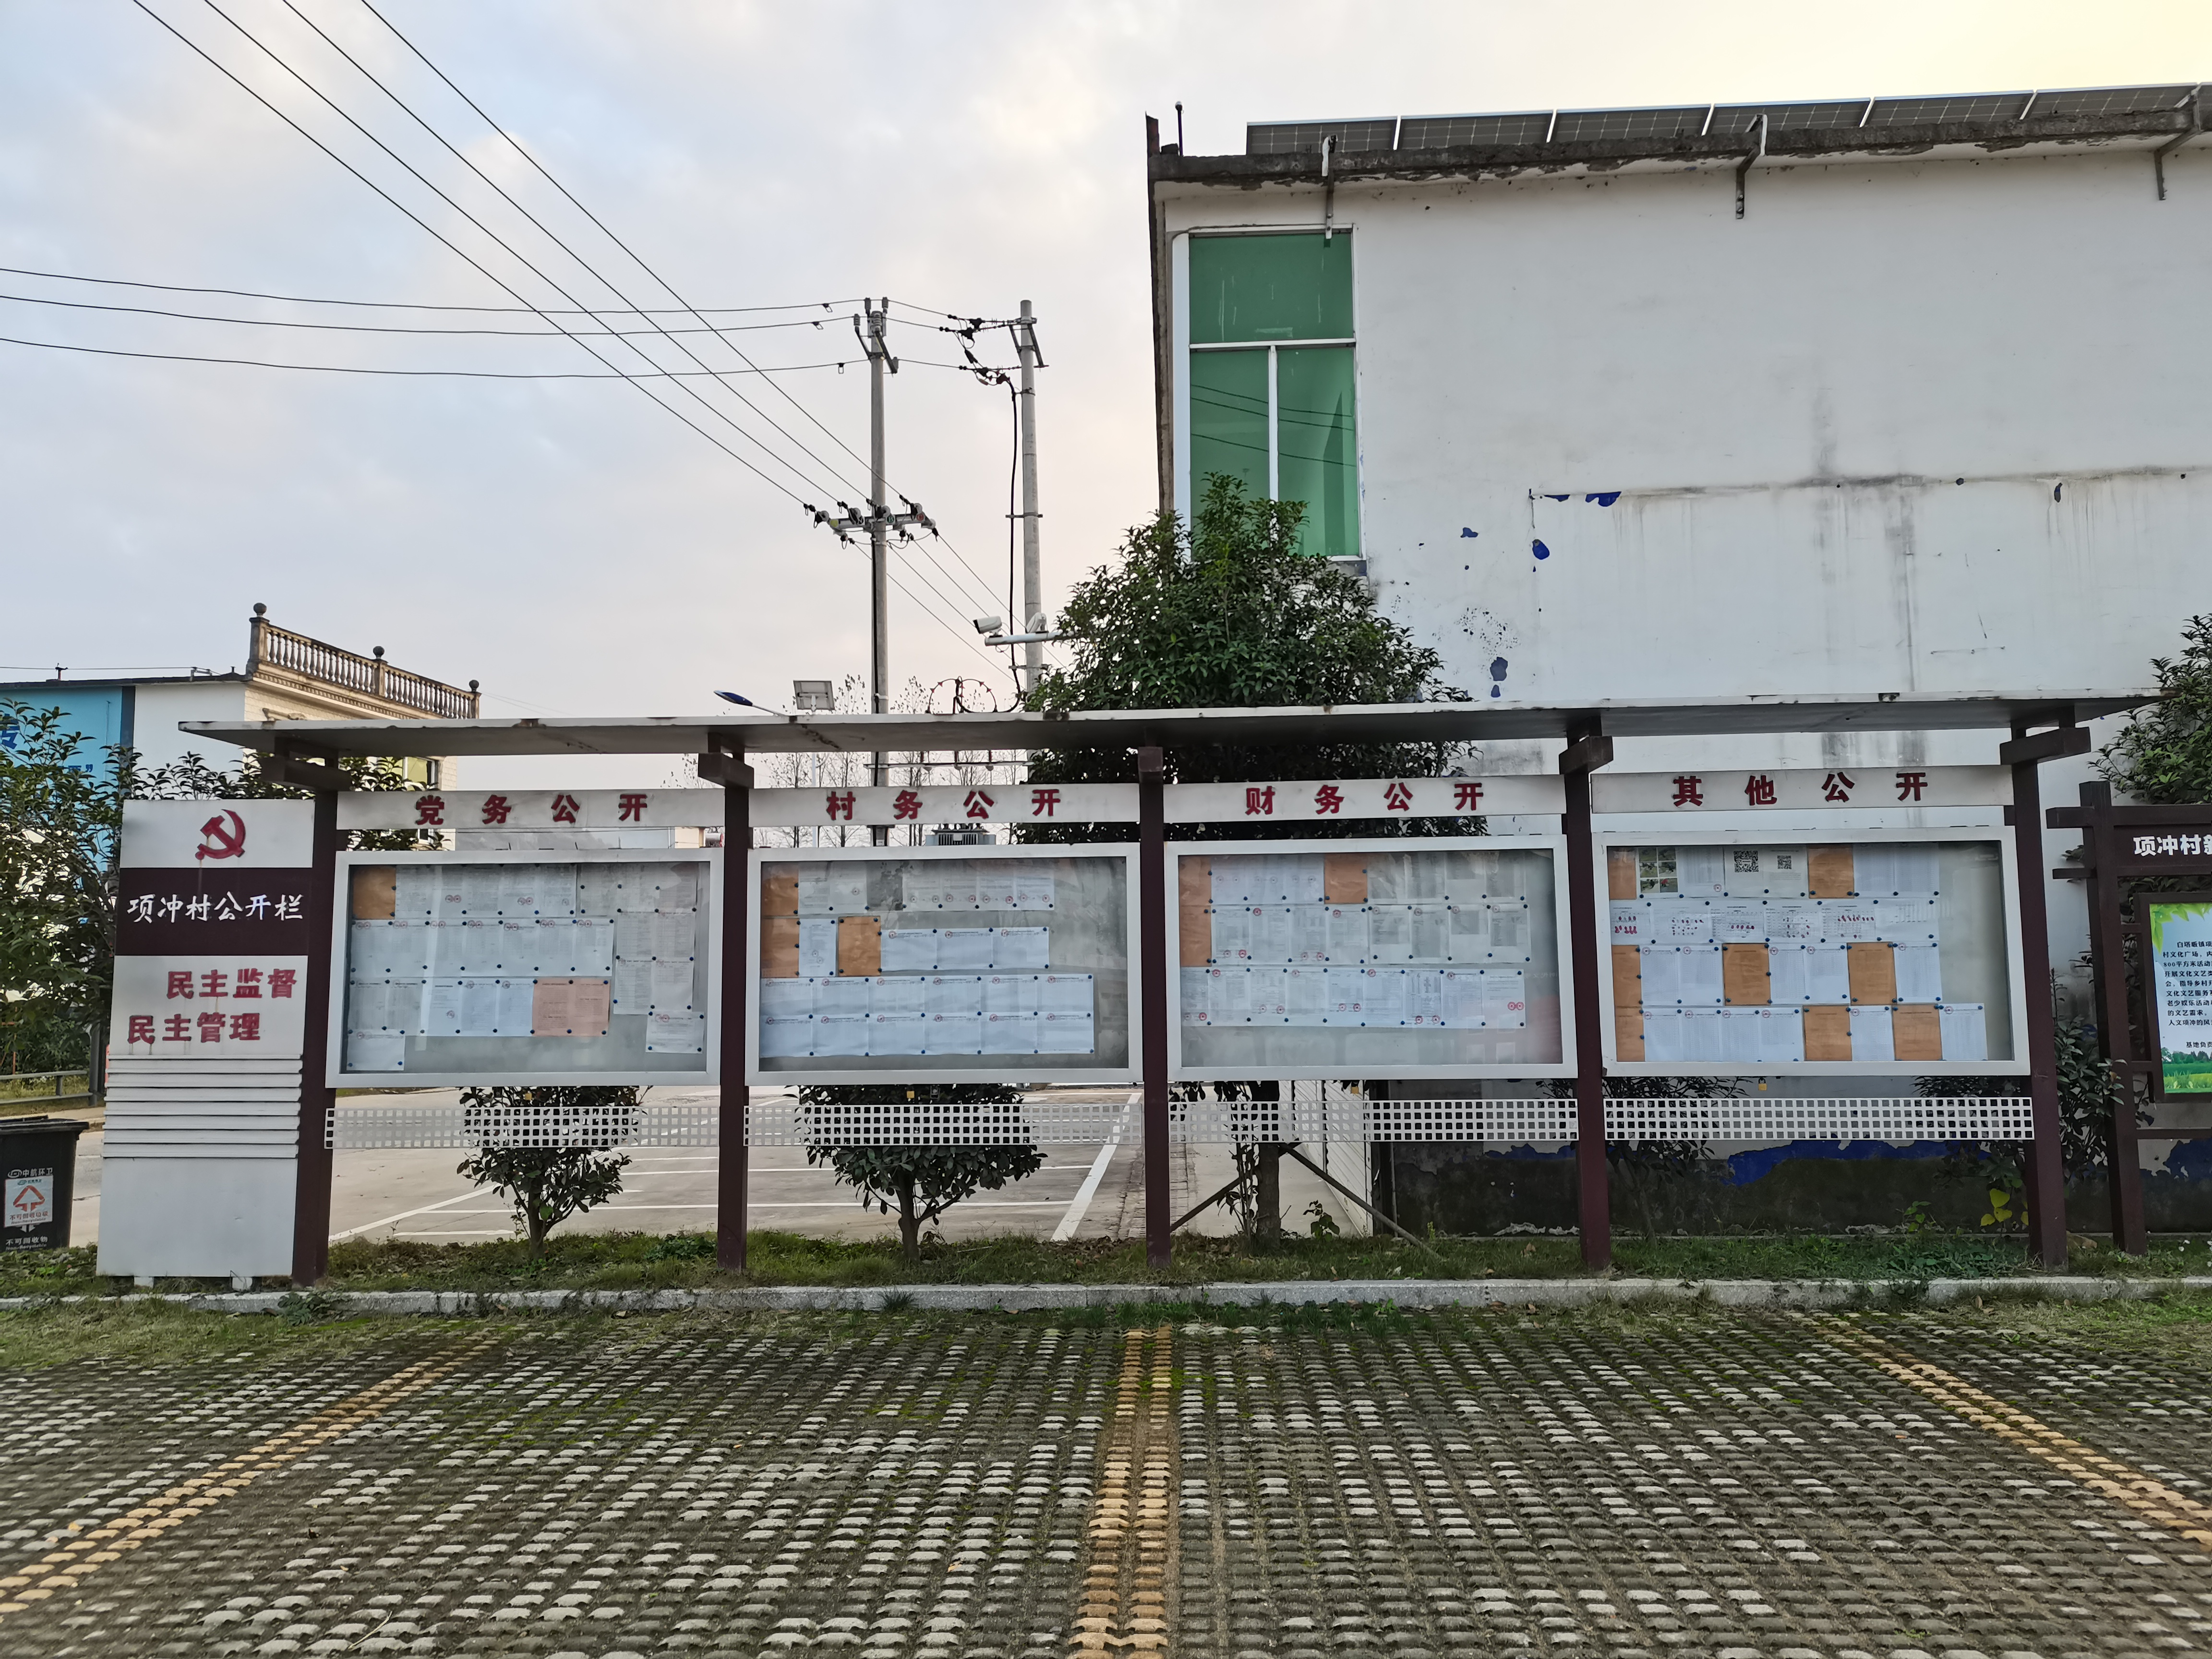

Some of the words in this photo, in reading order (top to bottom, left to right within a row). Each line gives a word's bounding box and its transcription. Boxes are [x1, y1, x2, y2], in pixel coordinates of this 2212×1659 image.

[826, 789, 1061, 820] 村务公开
[1245, 782, 1484, 815] 财务公开
[1673, 772, 1928, 807] 其他公开
[415, 794, 648, 825] 党务公开
[127, 891, 303, 924] 项冲村公开栏
[167, 968, 297, 999] 民主监督
[127, 1012, 261, 1045] 民主管理
[23, 1167, 53, 1177] 中航环卫
[5, 1235, 48, 1246] 不可回收物
